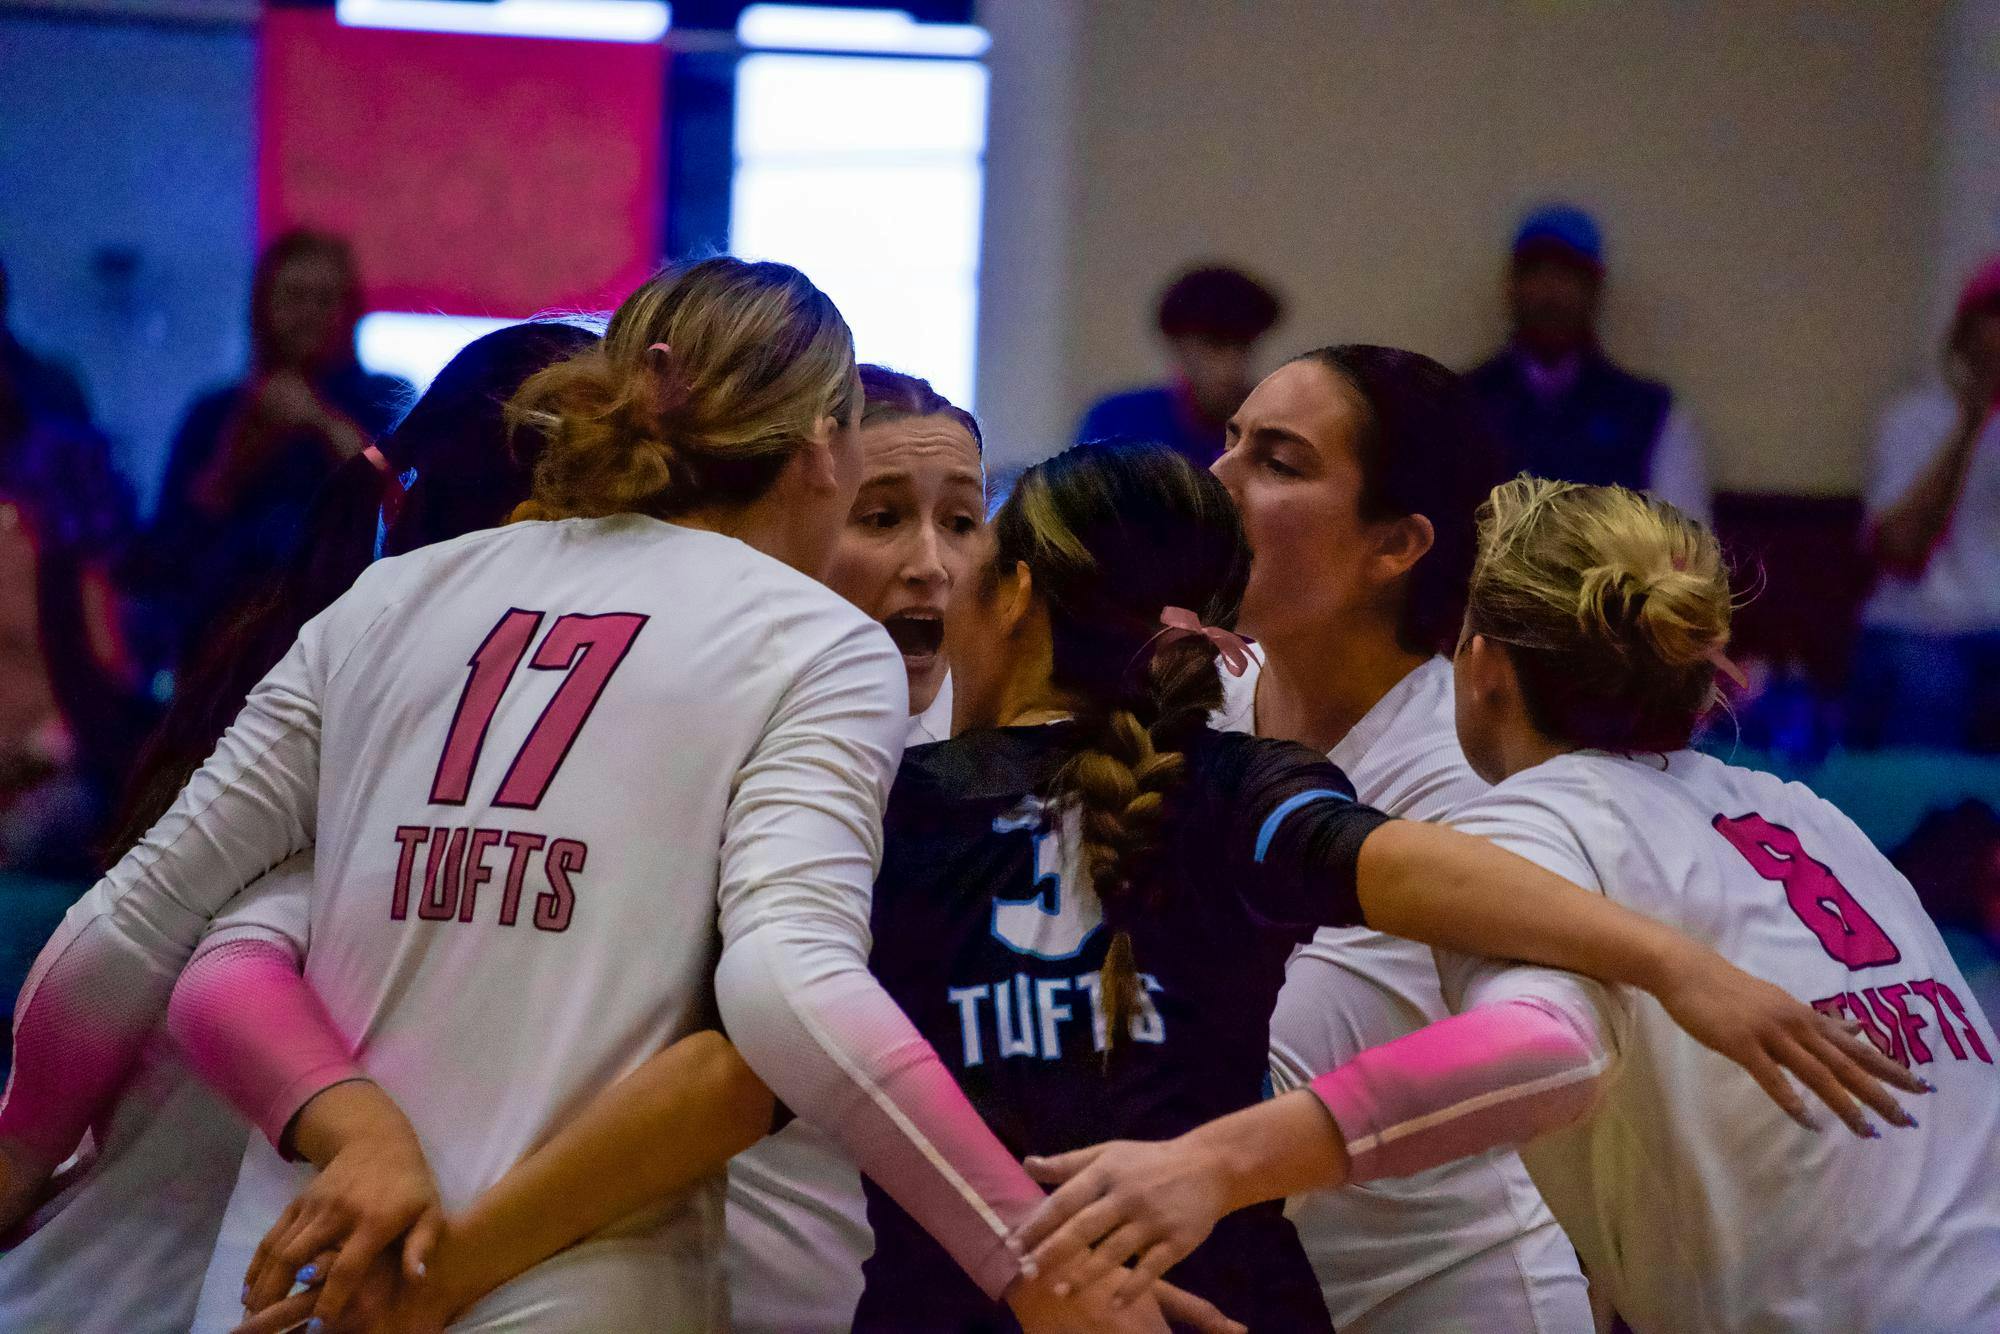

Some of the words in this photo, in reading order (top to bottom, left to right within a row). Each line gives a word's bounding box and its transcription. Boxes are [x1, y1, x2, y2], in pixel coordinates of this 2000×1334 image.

[428, 607, 651, 811] 17
[391, 826, 587, 933] TUFTS
[1711, 811, 1901, 972] 8
